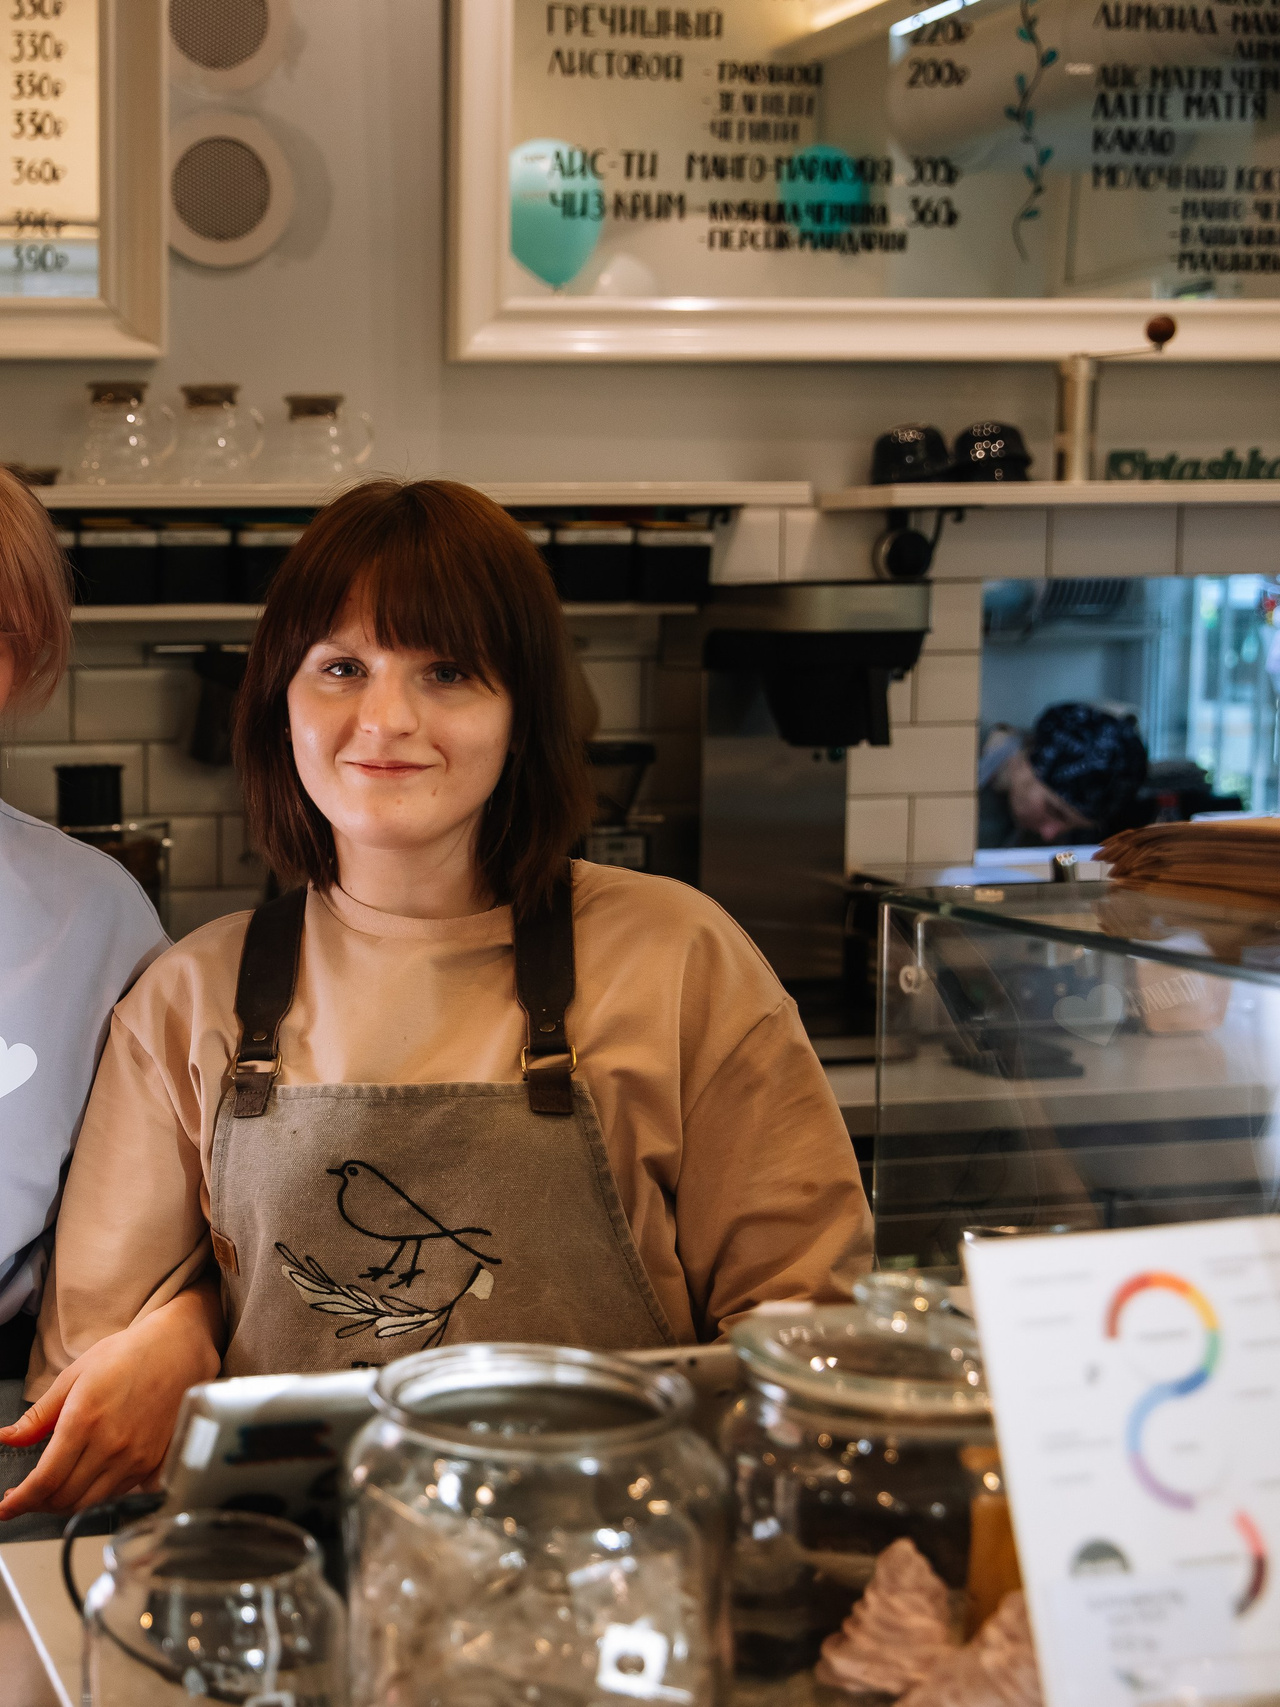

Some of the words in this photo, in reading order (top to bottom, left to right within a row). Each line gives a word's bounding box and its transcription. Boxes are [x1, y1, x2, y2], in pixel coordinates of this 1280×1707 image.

[545, 3, 724, 39] ГРЕЧИШНЫЙ
[547, 47, 683, 81] ЛИСТОВОЙ
[1092, 126, 1175, 156] КАКАО
